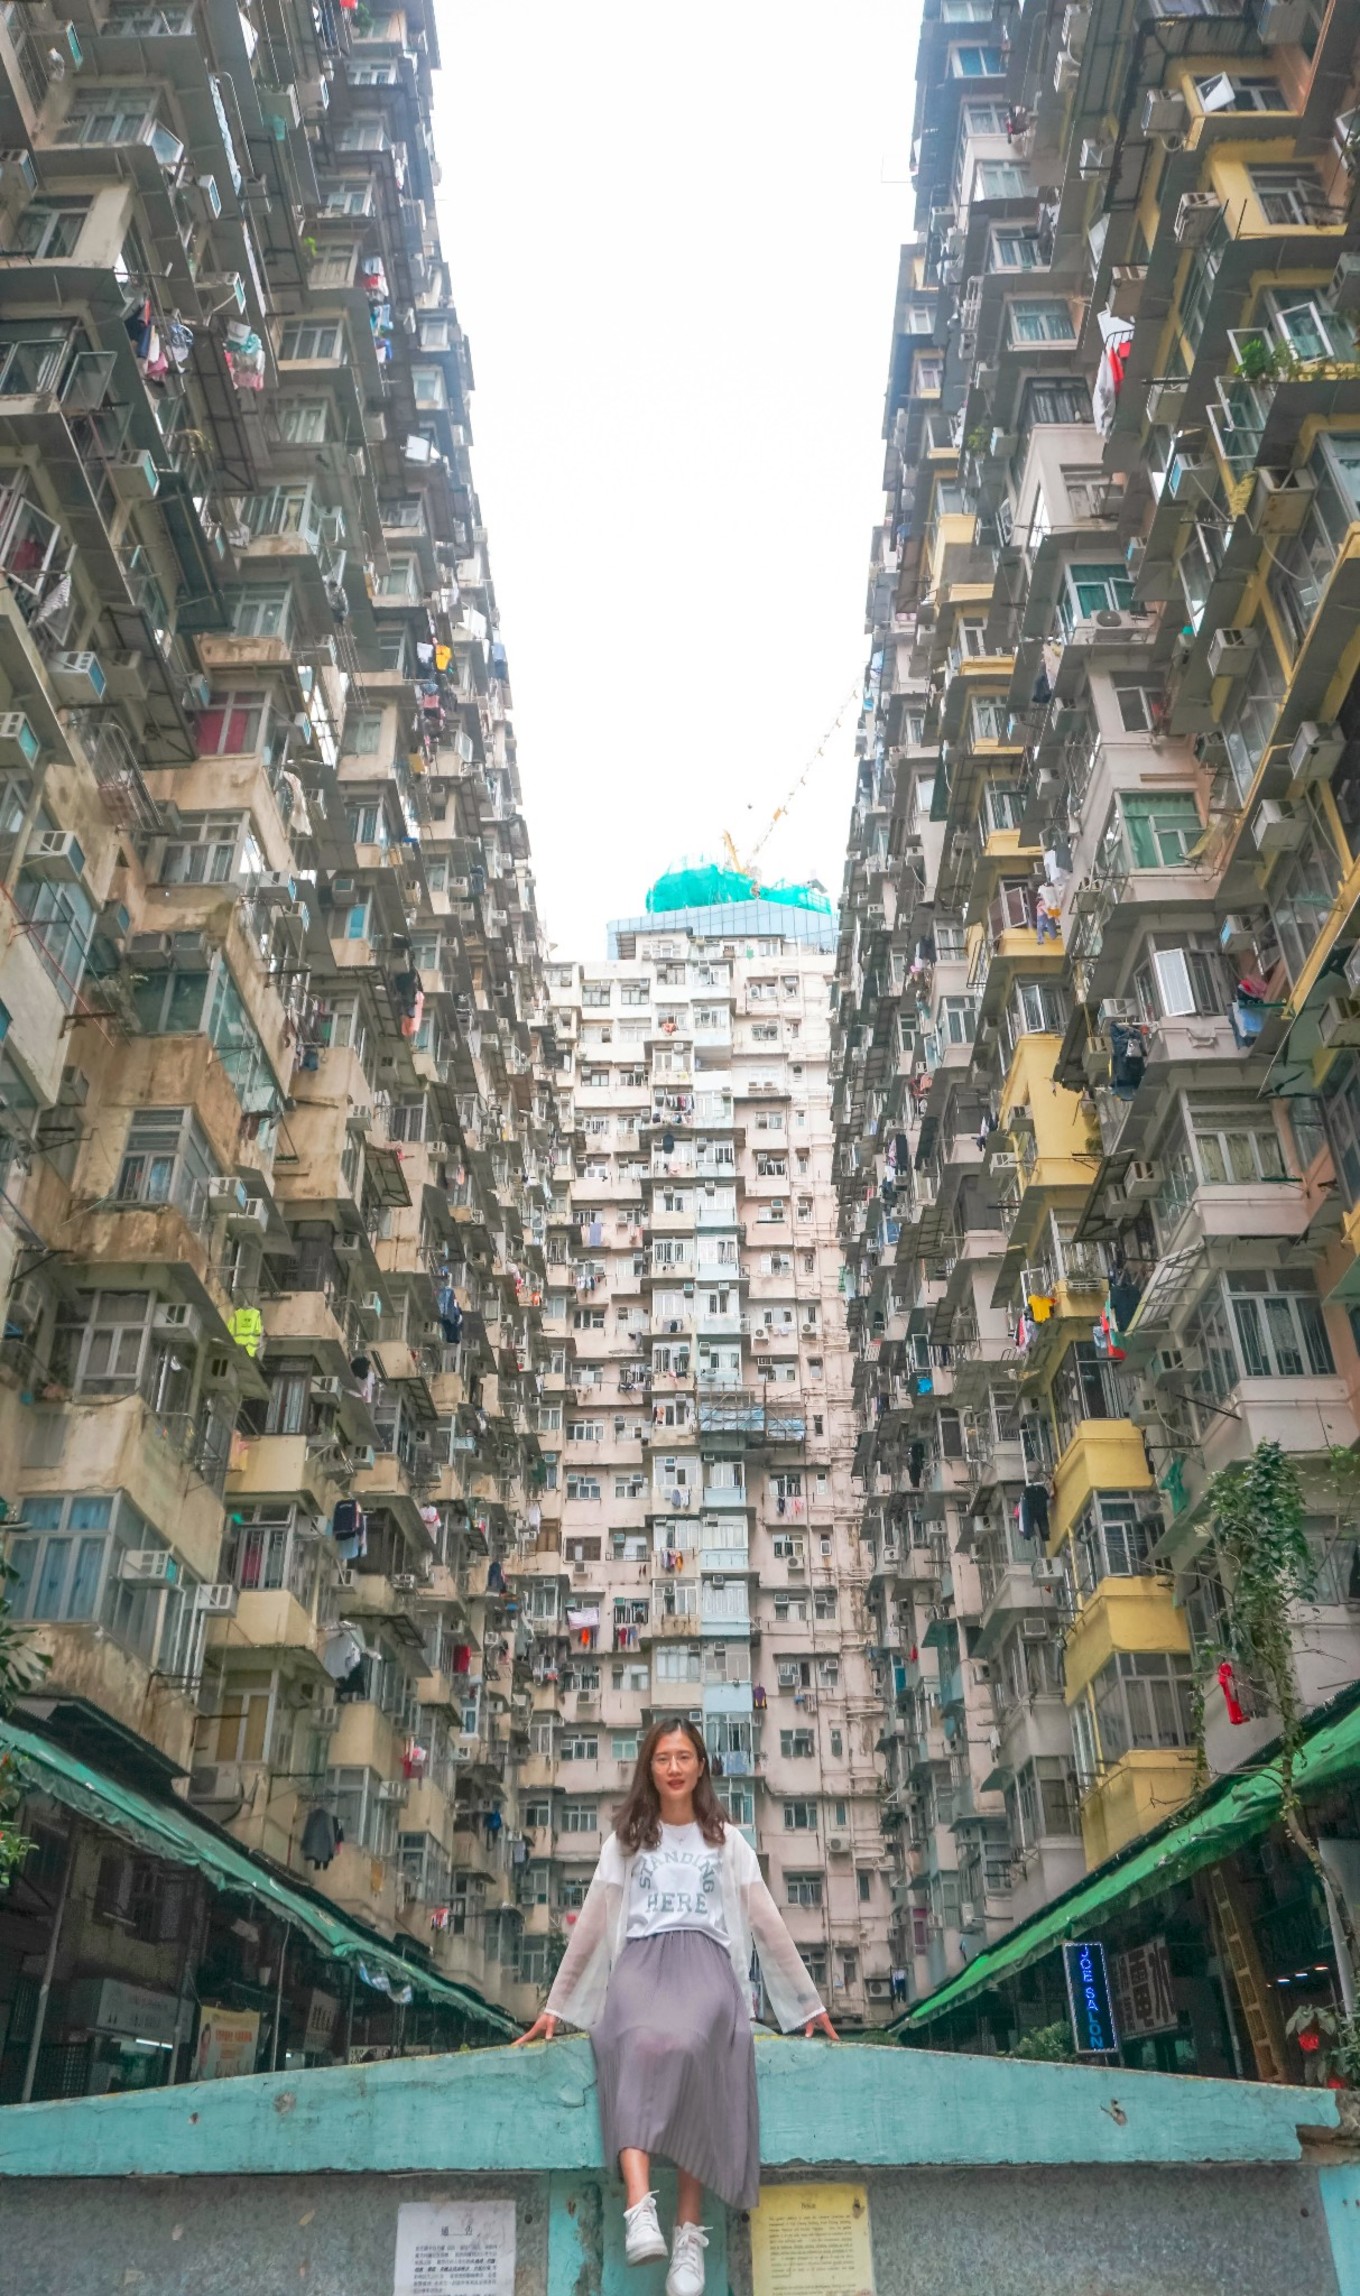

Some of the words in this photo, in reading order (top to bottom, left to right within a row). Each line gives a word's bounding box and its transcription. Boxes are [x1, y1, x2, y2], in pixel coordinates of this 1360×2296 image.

[639, 1850, 715, 1893] STANDING
[645, 1892, 708, 1914] HERE
[1080, 1945, 1092, 1982] JOE
[1085, 1988, 1103, 2048] SALON
